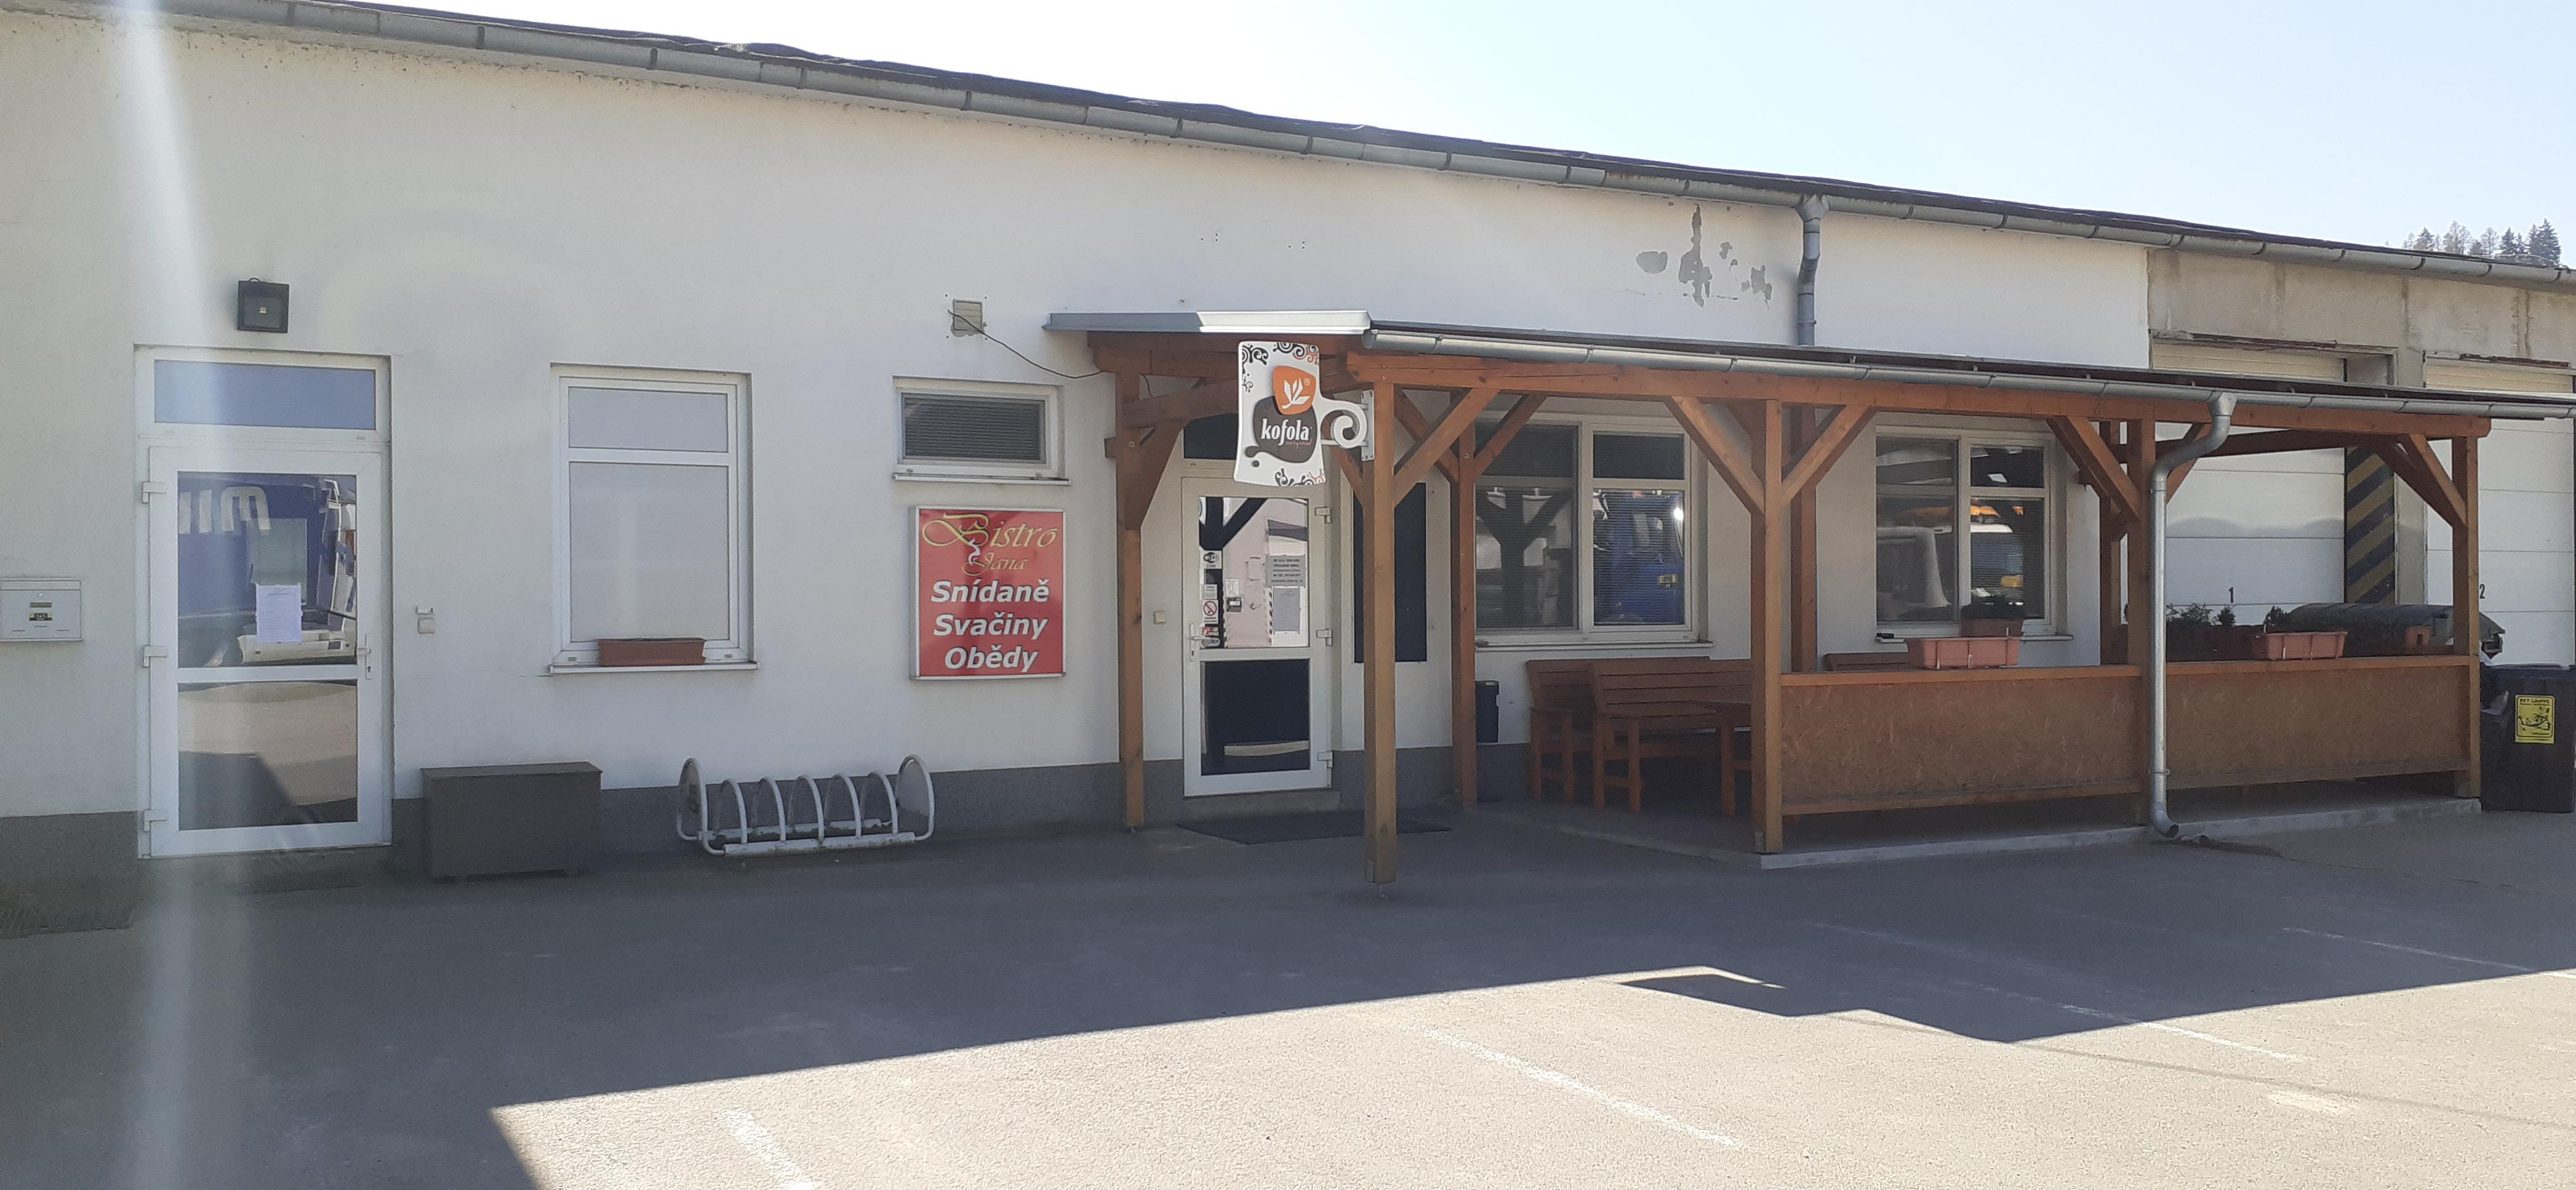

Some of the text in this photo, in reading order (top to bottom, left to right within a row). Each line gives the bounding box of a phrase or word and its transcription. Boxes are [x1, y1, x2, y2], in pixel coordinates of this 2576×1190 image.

[1260, 418, 1309, 446] kofola
[922, 513, 1058, 547] Bistro
[962, 552, 1028, 576] Jana
[931, 579, 1050, 603] Snídaně
[2228, 587, 2233, 603] 1
[2479, 583, 2485, 599] 2
[934, 611, 1048, 640] Svačiny
[945, 645, 1039, 672] Obědy
